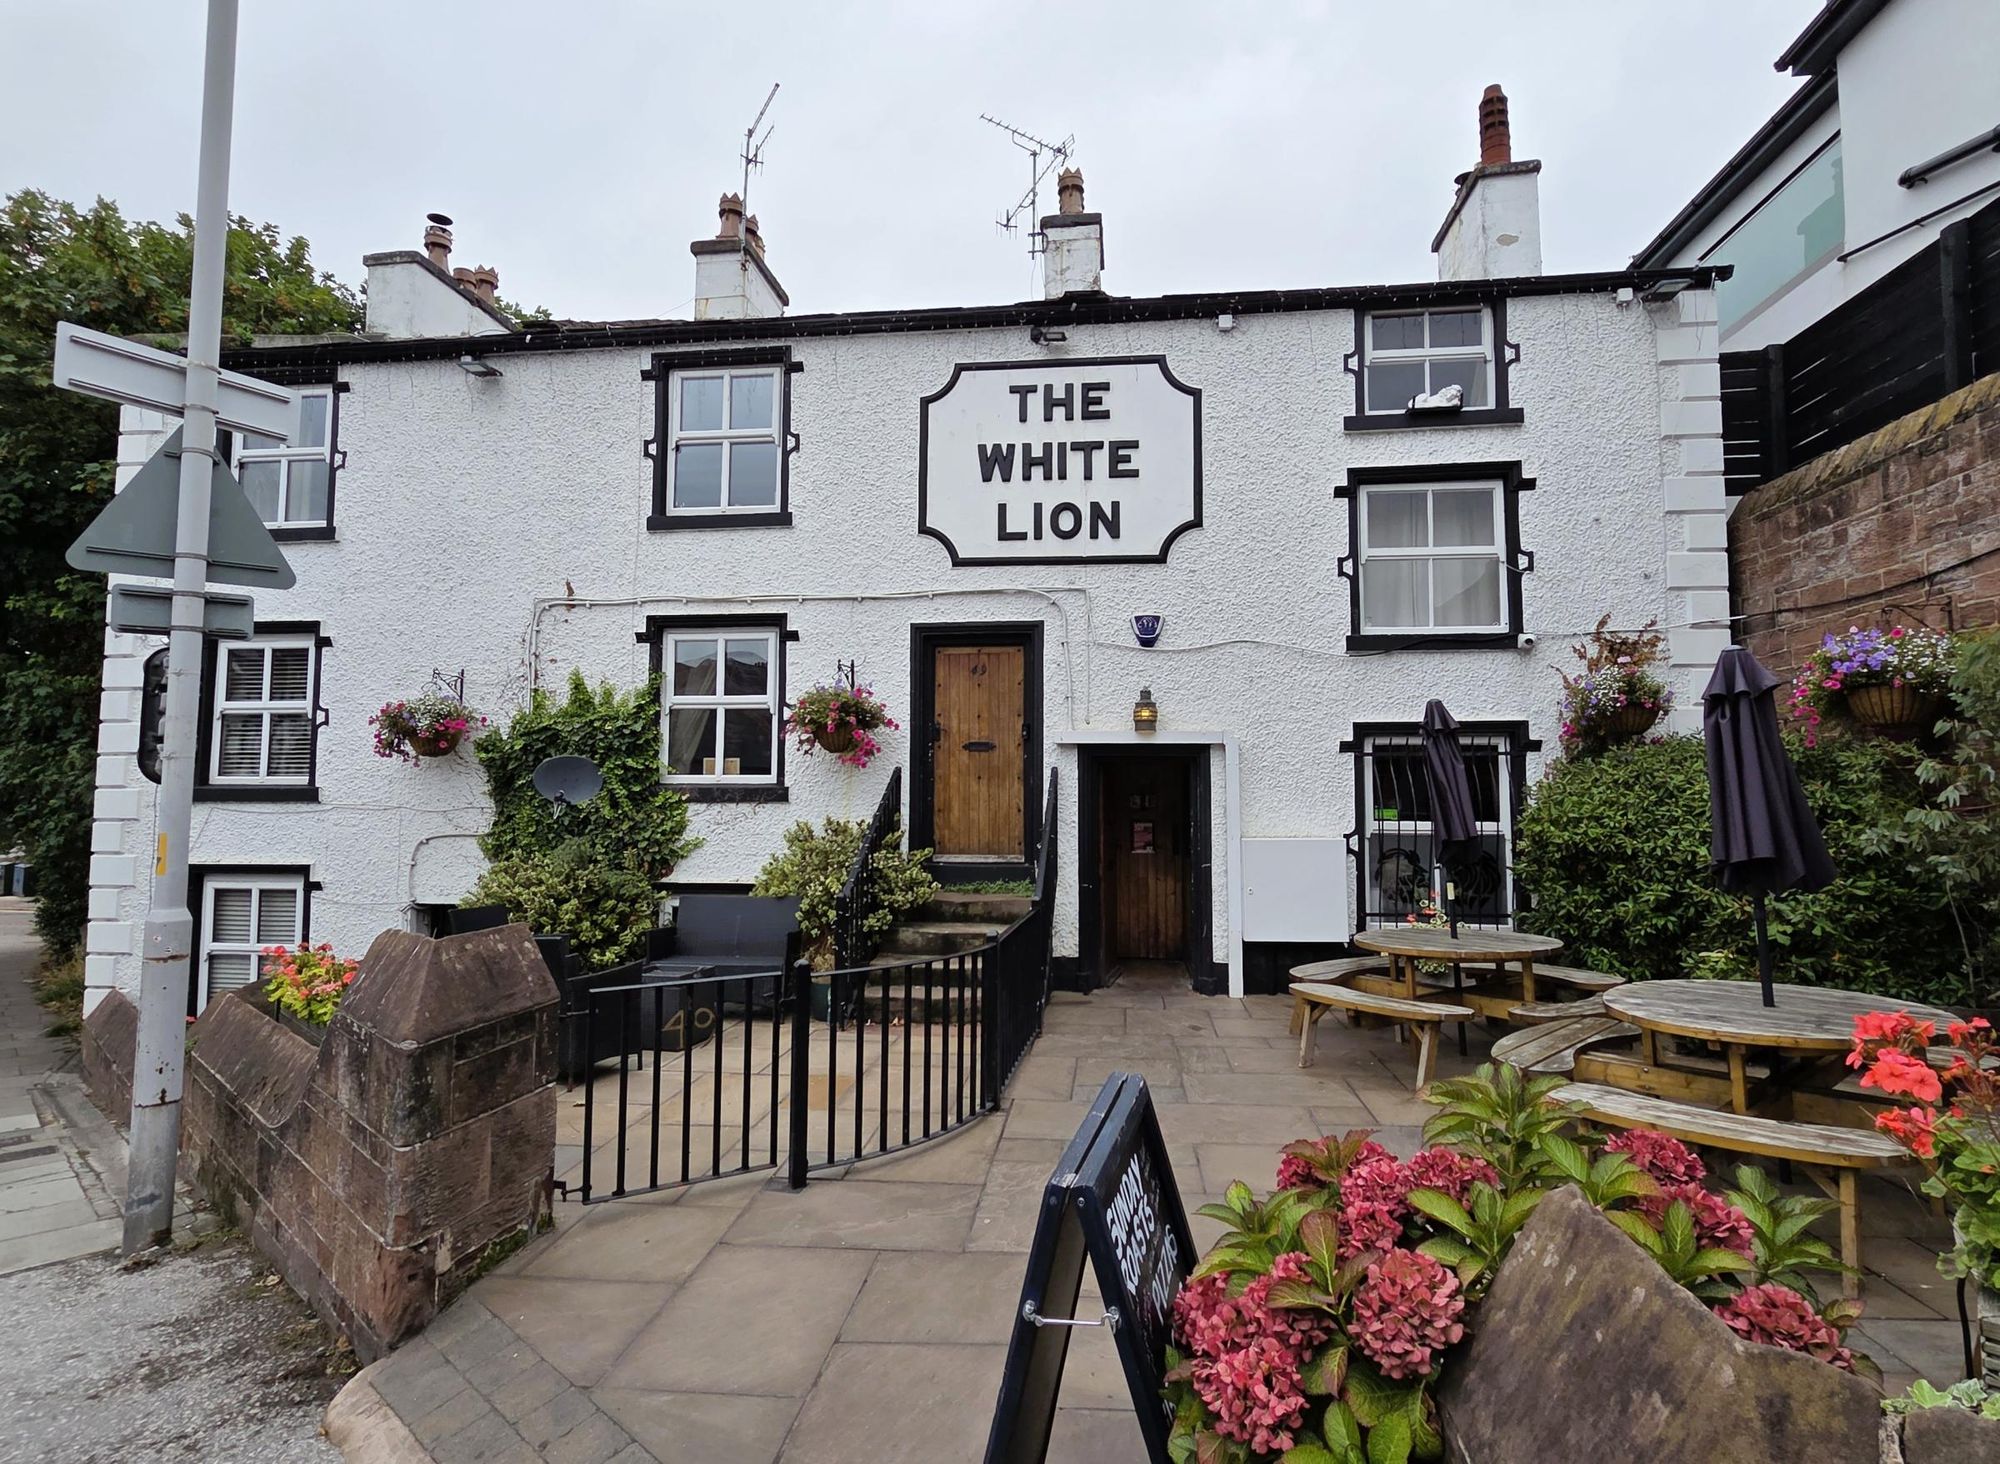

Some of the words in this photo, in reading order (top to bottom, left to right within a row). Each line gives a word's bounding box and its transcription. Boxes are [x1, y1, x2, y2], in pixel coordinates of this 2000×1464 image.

[1009, 382, 1110, 422] THE
[977, 440, 1140, 481] WHITE
[997, 501, 1120, 541] LION
[1106, 1153, 1144, 1260] SUNDAY
[1120, 1193, 1155, 1296] ROASTS
[1151, 1224, 1178, 1326] PIZZAS
